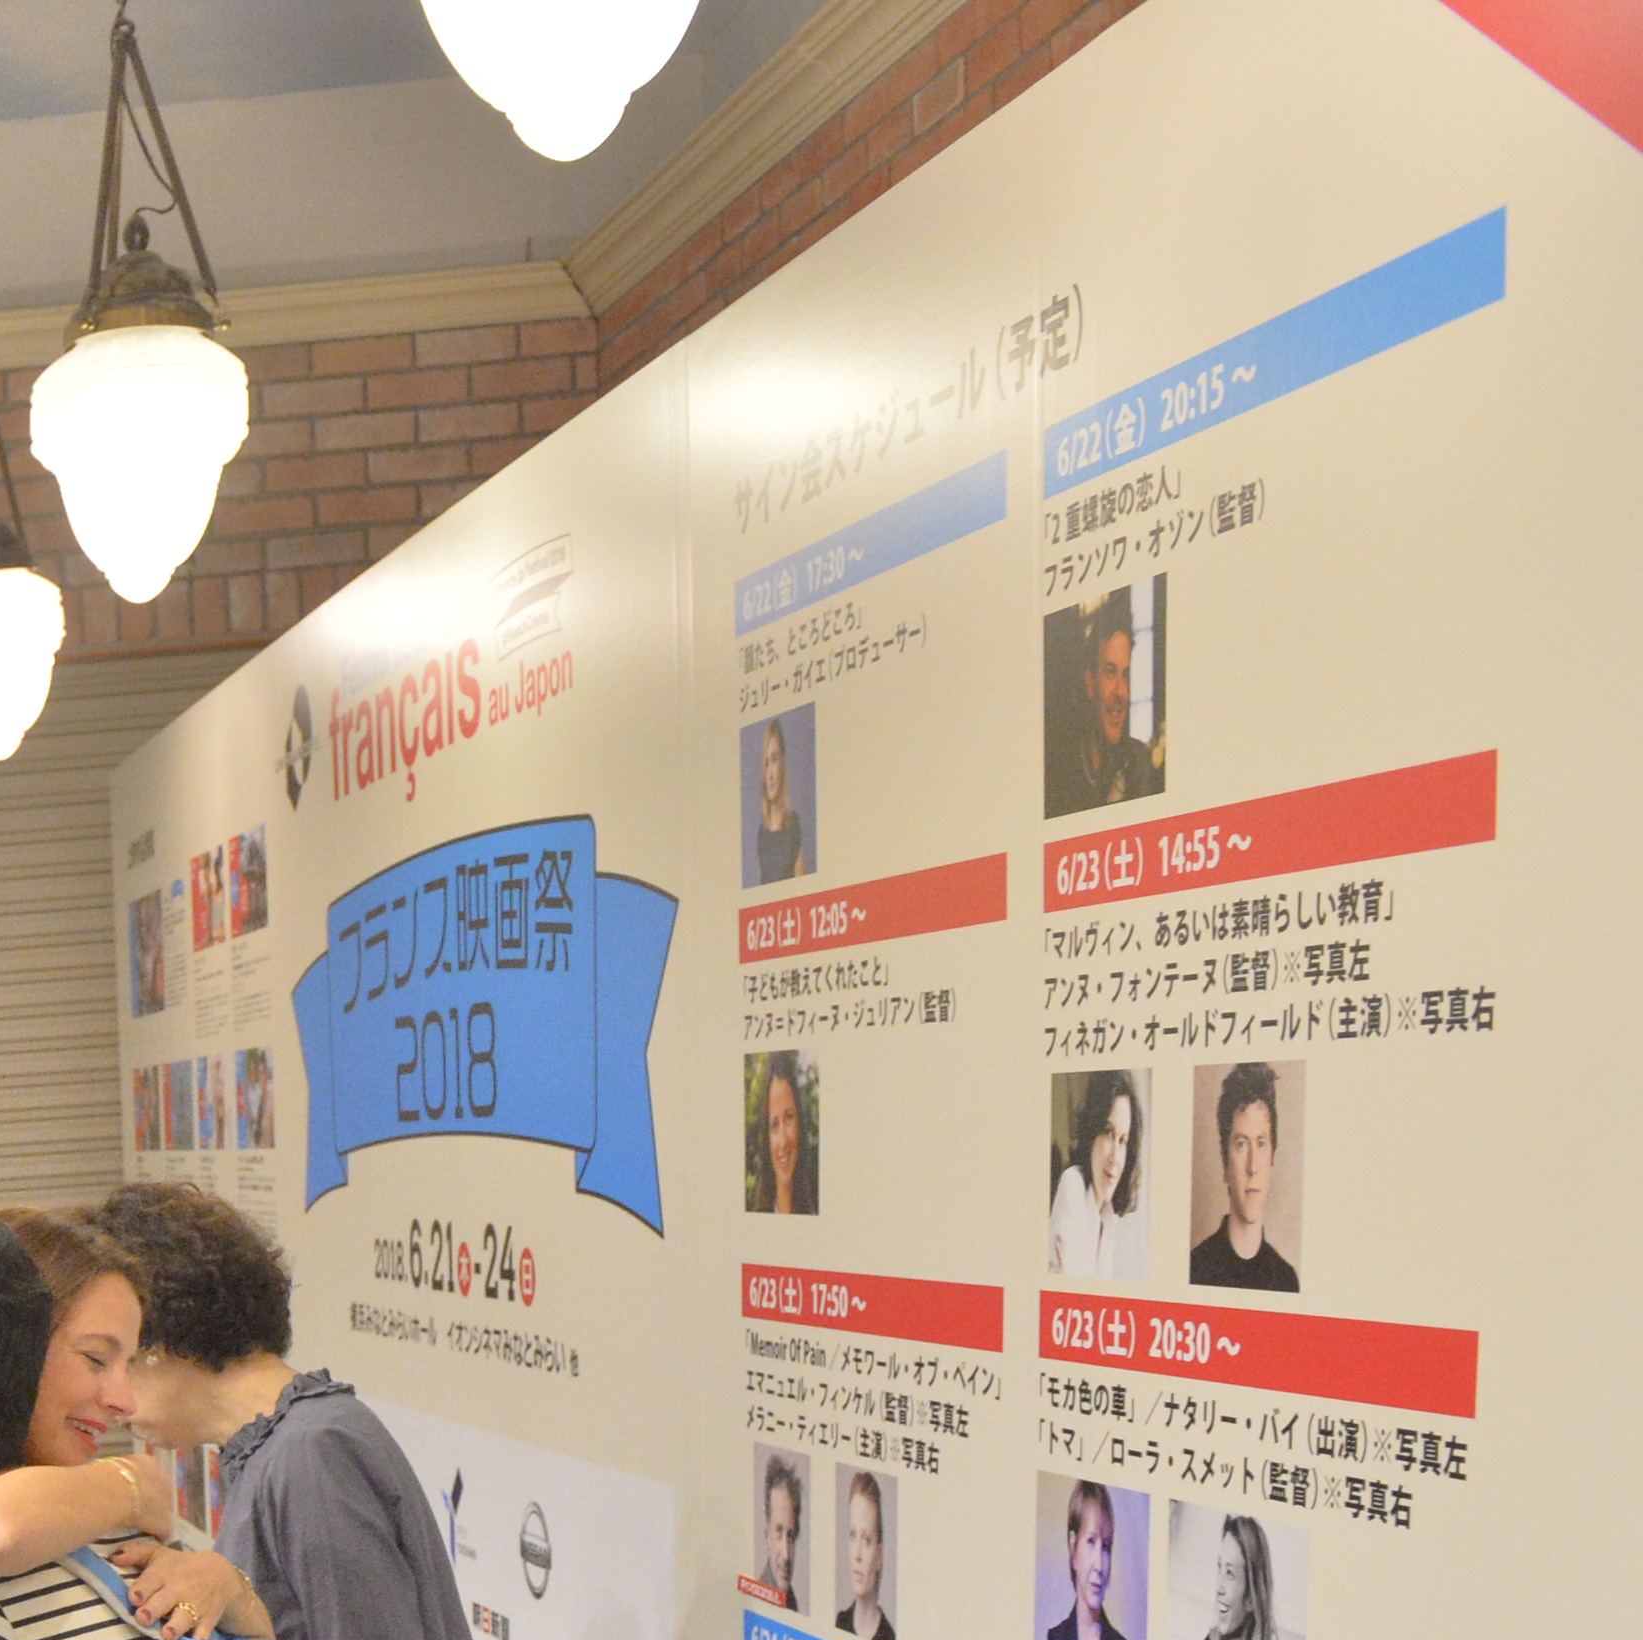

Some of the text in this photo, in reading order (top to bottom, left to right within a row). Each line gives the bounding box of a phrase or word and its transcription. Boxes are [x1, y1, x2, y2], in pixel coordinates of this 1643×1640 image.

[1045, 478, 1265, 596] フランソワ・オゾン（監督）
[330, 637, 481, 801] français
[488, 681, 510, 726] au
[515, 650, 573, 716] Japon
[339, 848, 573, 1015] フランス映画祭
[1045, 879, 1393, 959] 「マルヴィン、あるいは素晴らしい教育」
[395, 1002, 497, 1122] 2018
